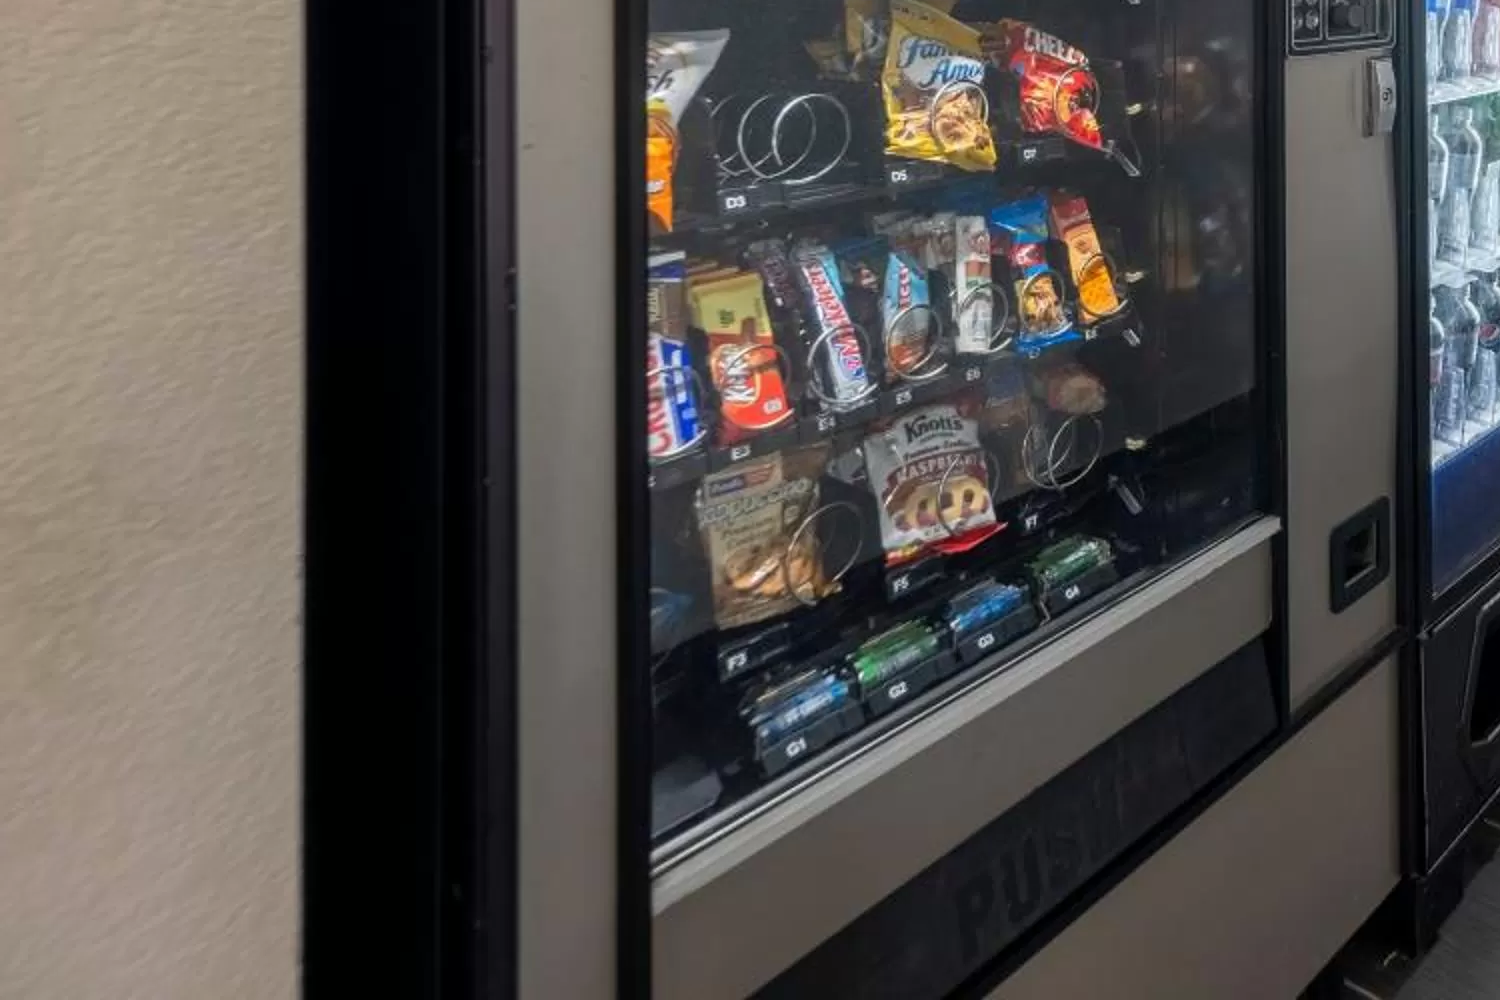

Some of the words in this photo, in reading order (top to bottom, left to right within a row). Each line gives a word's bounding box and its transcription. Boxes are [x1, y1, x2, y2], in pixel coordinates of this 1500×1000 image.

[891, 169, 908, 183] D5
[725, 194, 747, 209] D3
[892, 574, 910, 594] F5
[726, 650, 748, 671] F3
[888, 680, 908, 700] G2
[786, 736, 807, 758] G1
